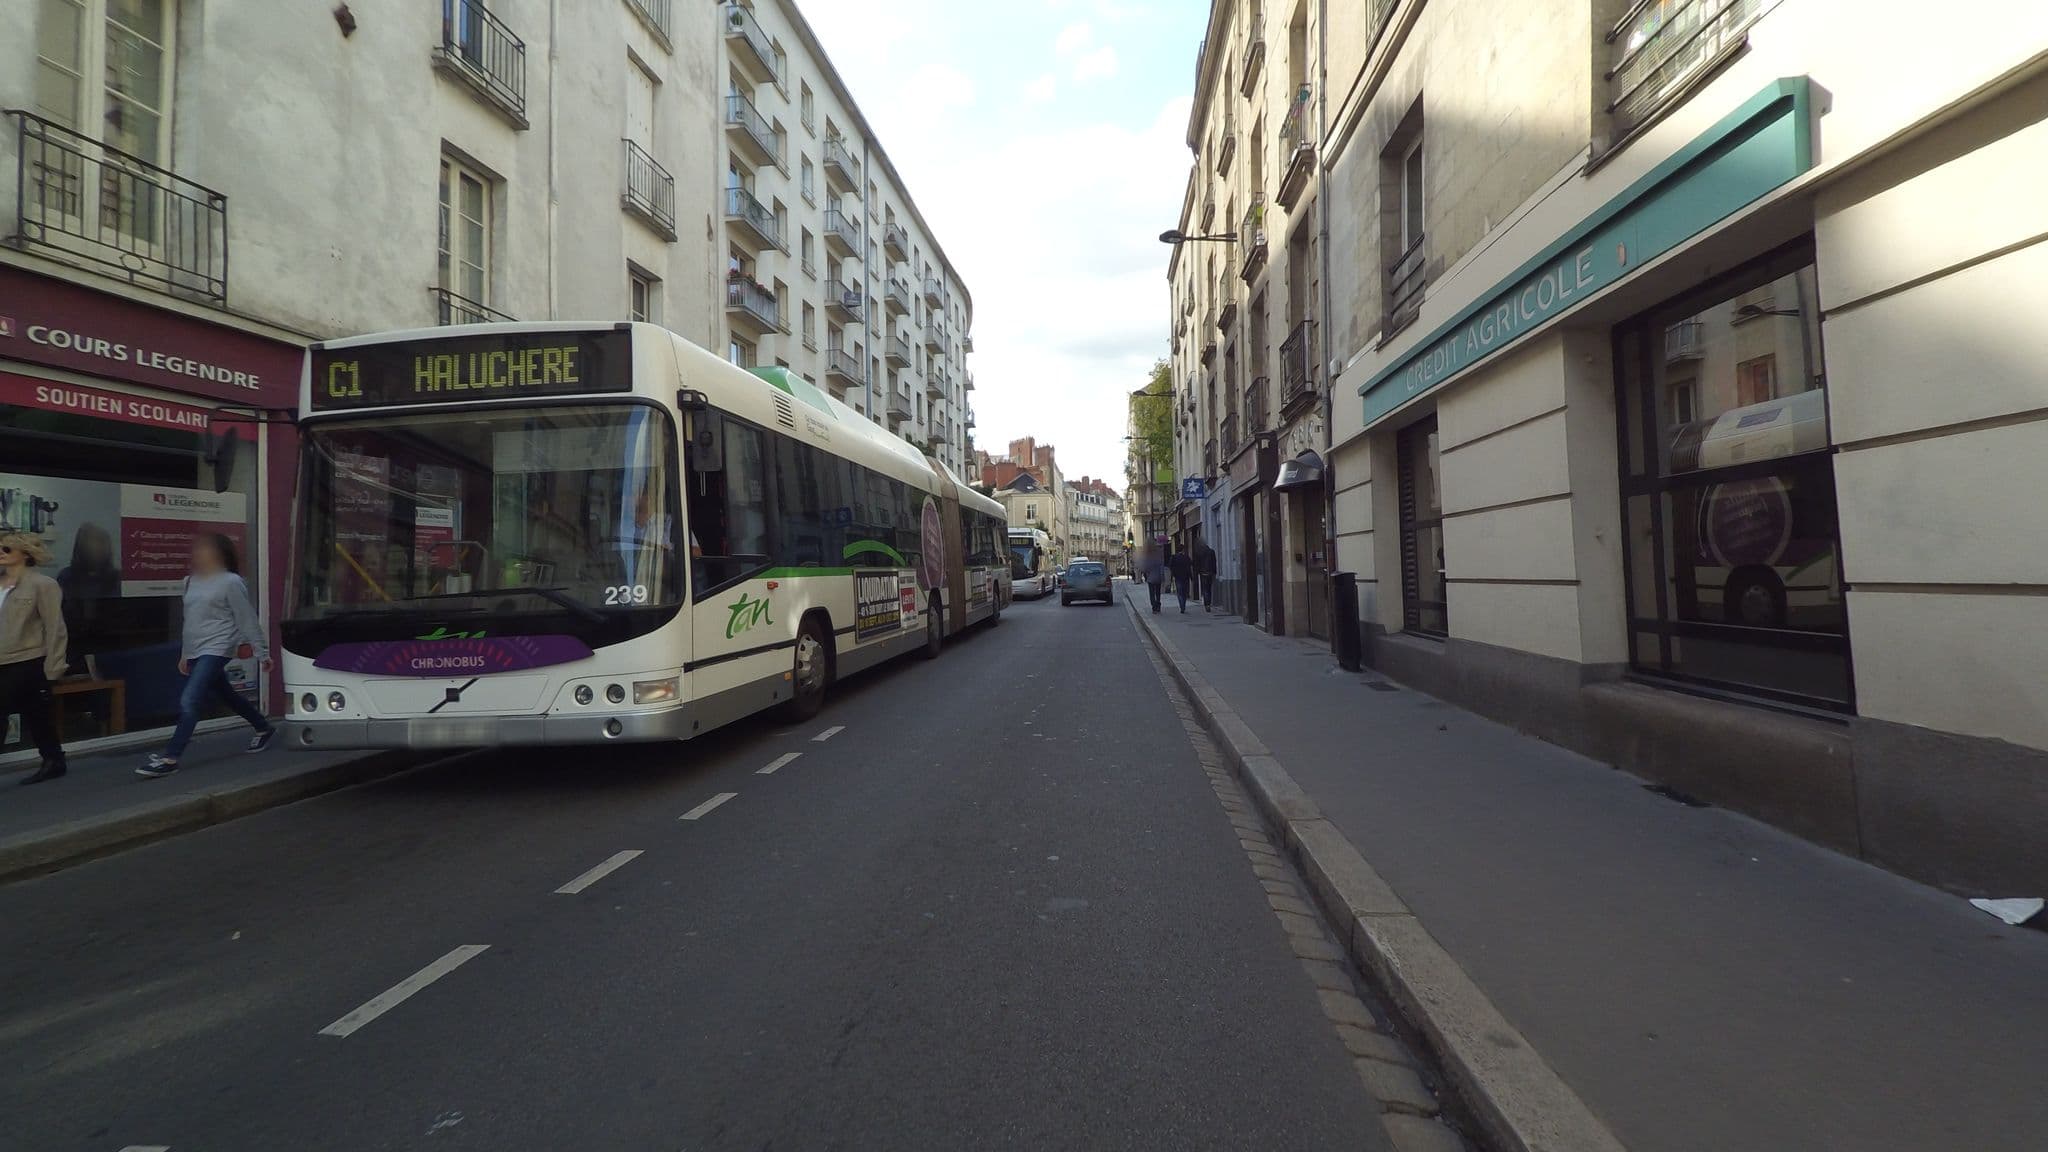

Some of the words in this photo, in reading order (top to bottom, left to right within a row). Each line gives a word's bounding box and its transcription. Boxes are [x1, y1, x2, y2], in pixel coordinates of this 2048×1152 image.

[1466, 247, 1594, 354] AGRICOLE
[26, 325, 128, 361] COURS
[137, 349, 260, 390] LEGENDRE
[328, 360, 363, 398] C1
[414, 347, 579, 392] HALUCHERE
[36, 387, 122, 415] SOUTIEN
[128, 402, 207, 428] SCOLAIR
[604, 585, 648, 605] 239
[857, 576, 898, 605] LIQUIDATION
[725, 592, 773, 639] tan
[411, 656, 485, 669] CHRONOBUS
